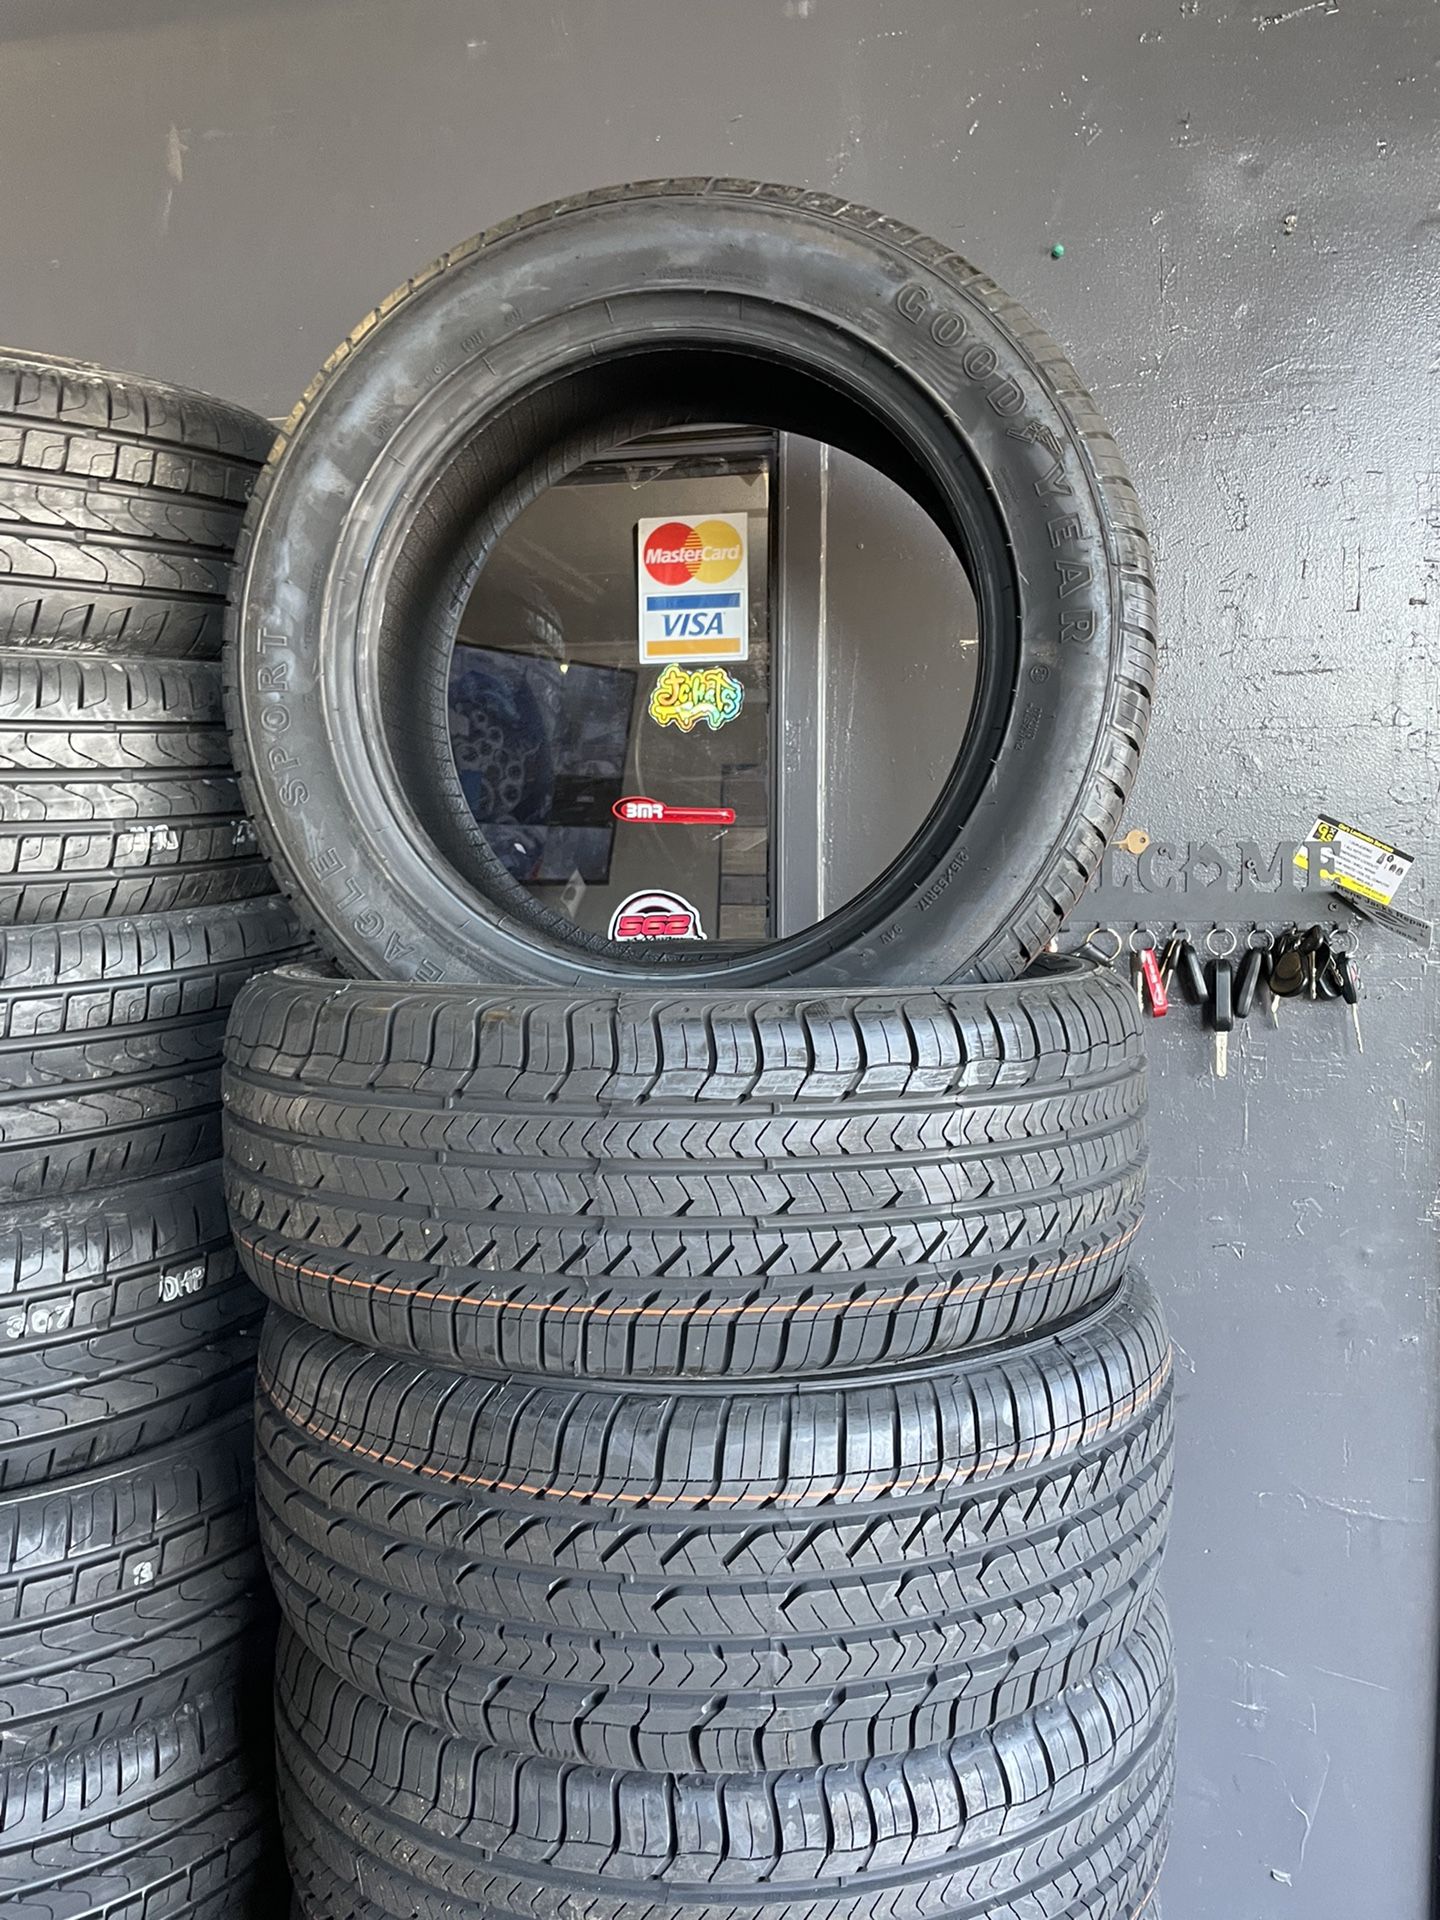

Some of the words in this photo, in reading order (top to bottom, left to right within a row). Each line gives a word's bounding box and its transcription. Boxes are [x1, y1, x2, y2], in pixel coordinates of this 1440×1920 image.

[896, 281, 1097, 644] GOODYEAR
[645, 544, 740, 564] MasterCard
[661, 611, 725, 637] VISA
[256, 628, 311, 808] SPORT
[309, 847, 447, 982] EAGLE
[617, 913, 692, 937] 562
